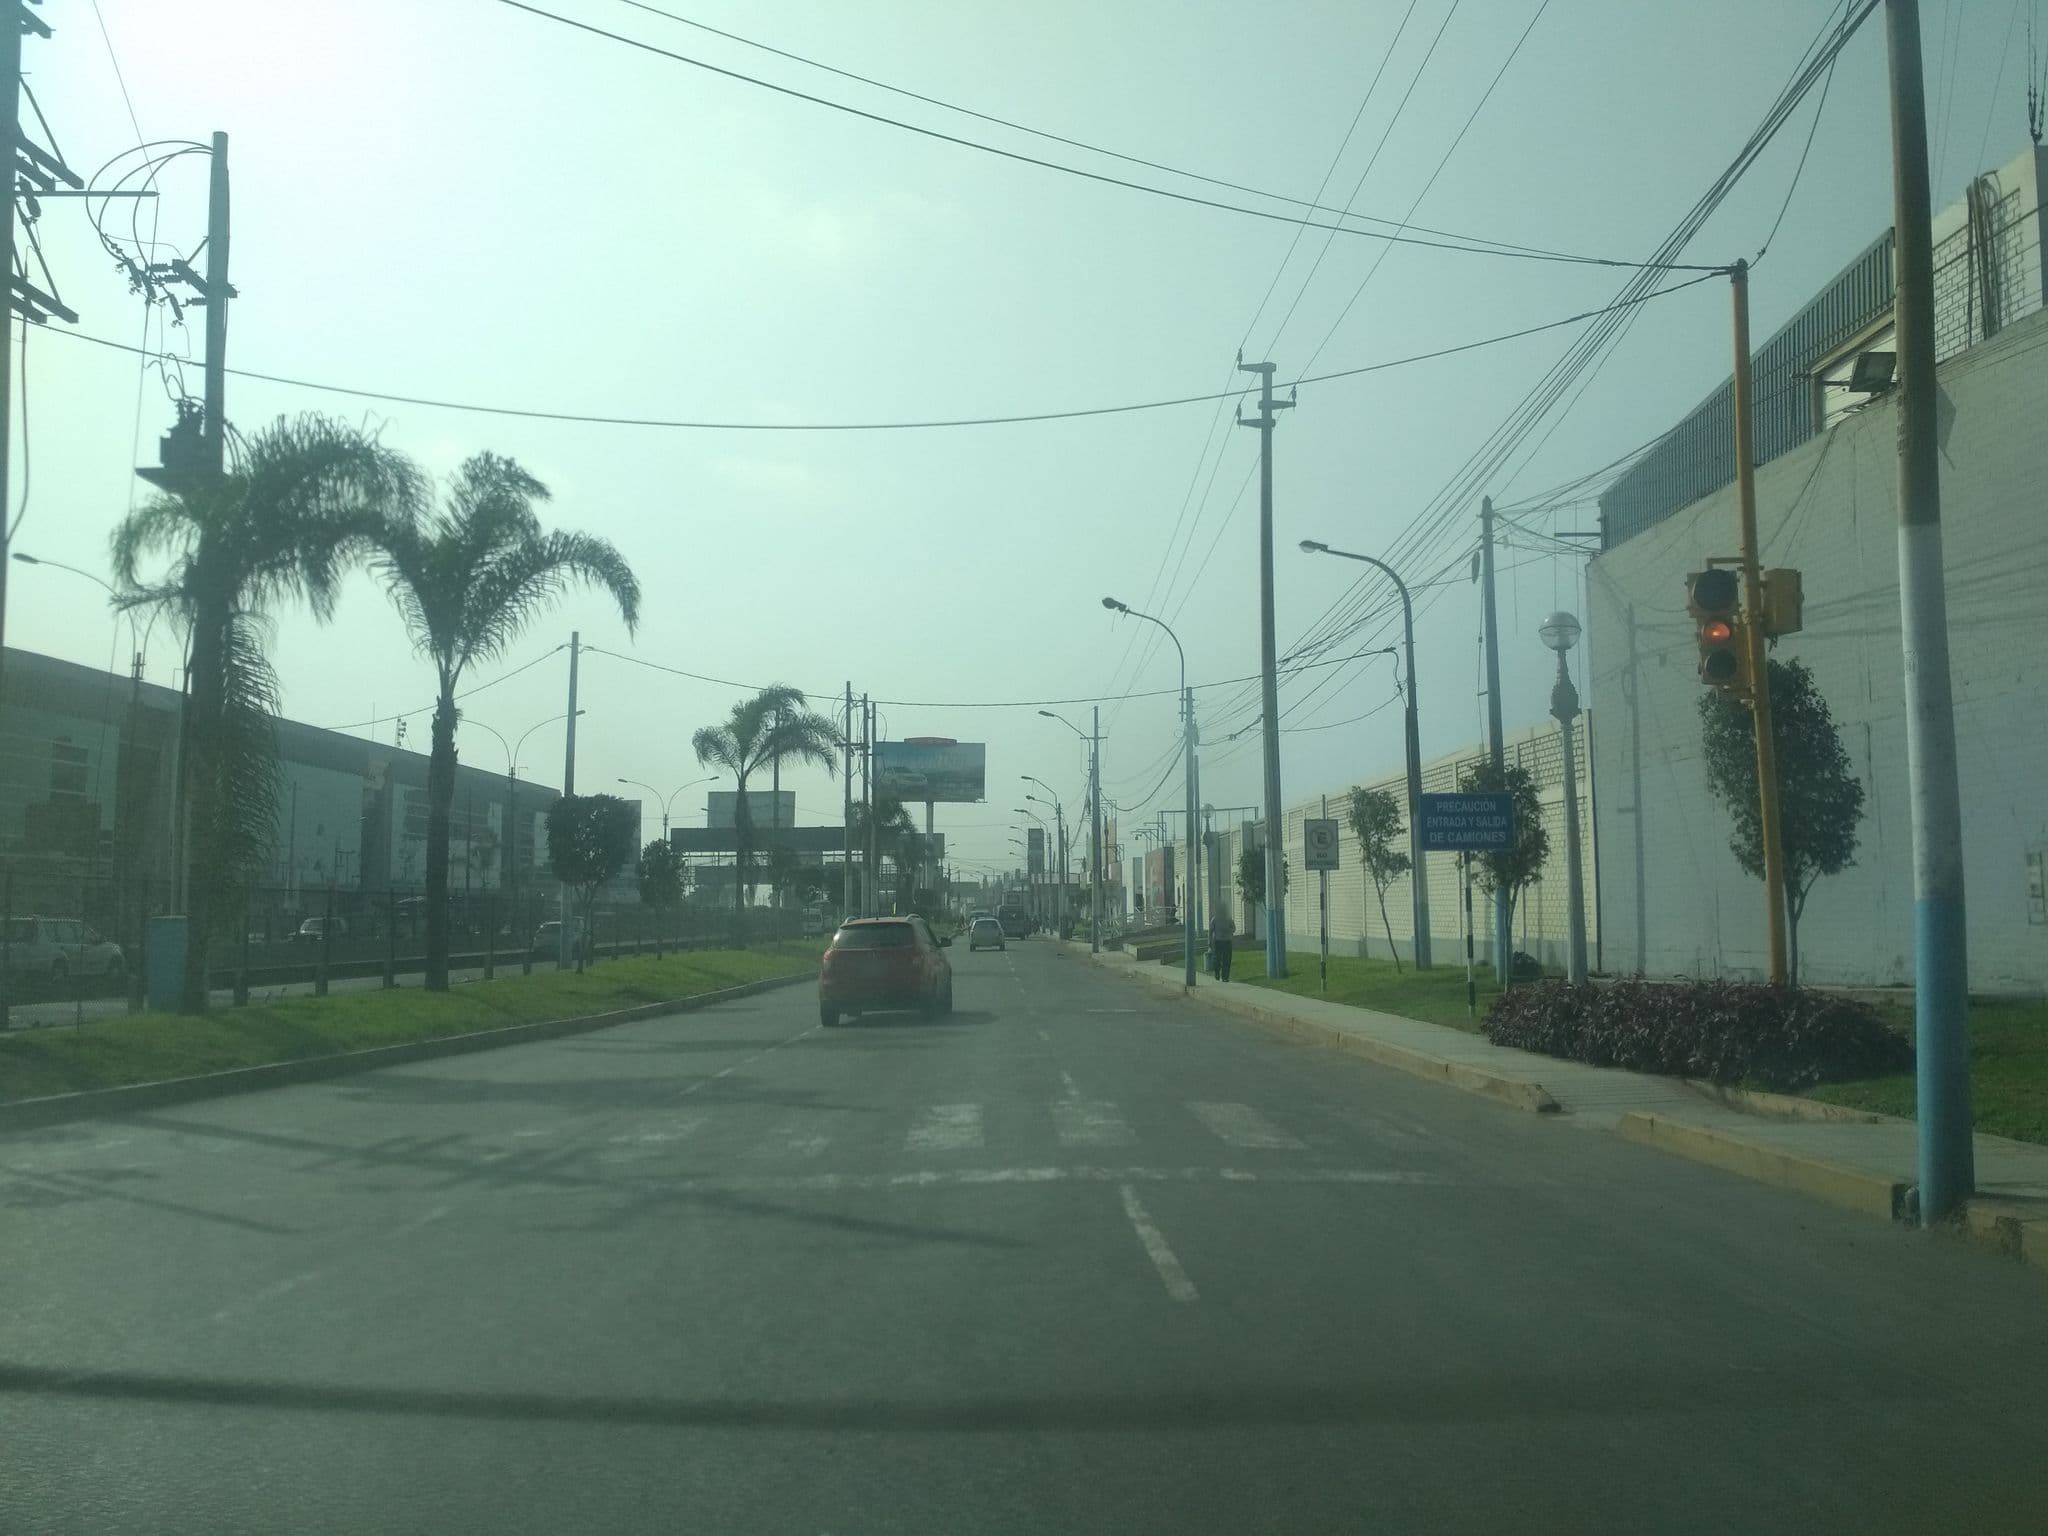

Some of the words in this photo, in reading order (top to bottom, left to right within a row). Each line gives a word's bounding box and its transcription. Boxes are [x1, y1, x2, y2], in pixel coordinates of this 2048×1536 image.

[1426, 816, 1467, 827] ENTRADA
[1467, 816, 1474, 827] Y
[1475, 816, 1507, 827] SALIDA
[1317, 832, 1328, 844] E
[1429, 832, 1444, 843] DE
[1447, 832, 1506, 843] CAMIONES
